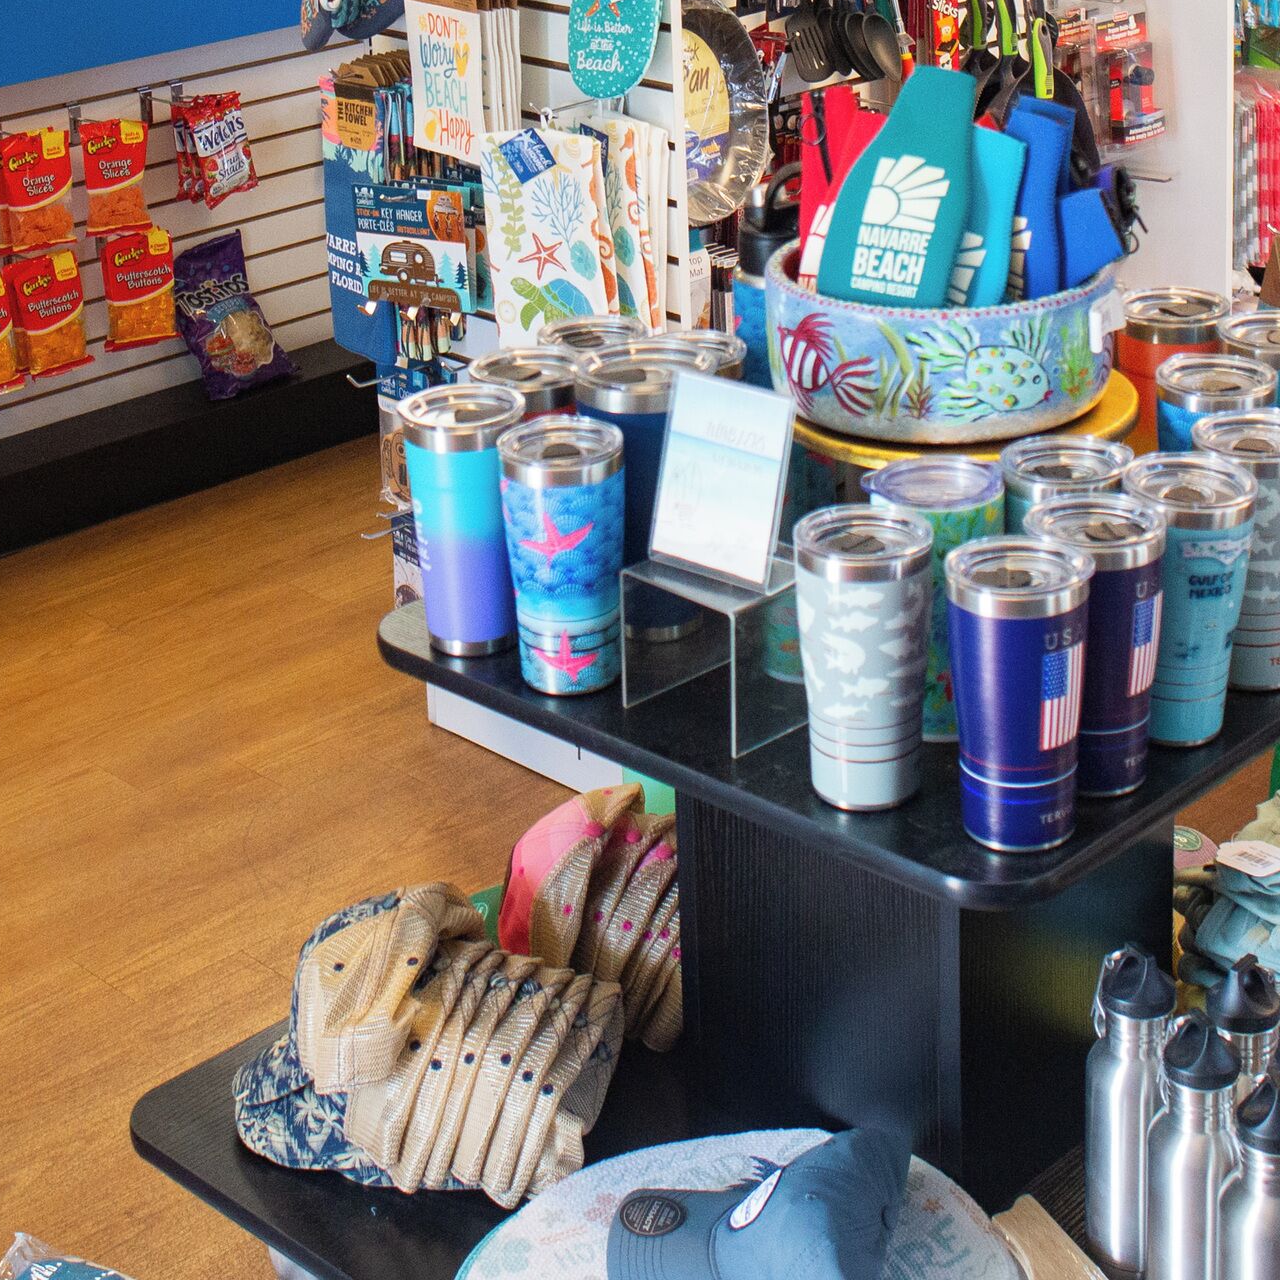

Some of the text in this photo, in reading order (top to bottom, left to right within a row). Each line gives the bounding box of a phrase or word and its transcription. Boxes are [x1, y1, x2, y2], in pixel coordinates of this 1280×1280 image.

[427, 13, 460, 40] DON'T
[576, 20, 633, 34] Life Better
[420, 35, 456, 78] Worry
[577, 49, 624, 72] Beach
[424, 72, 468, 115] BEACH
[345, 103, 372, 117] KITCHEN
[345, 115, 367, 126] TOWEL
[198, 115, 245, 149] Welch's
[439, 110, 474, 155] Happy
[99, 158, 132, 169] Orange
[23, 175, 55, 186] Orange
[102, 168, 130, 179] Slices
[27, 184, 54, 196] Slices
[381, 207, 423, 222] KEY HANGER
[857, 224, 932, 255] NAVARRE
[116, 265, 170, 281] Butterscotch
[852, 247, 926, 284] BEACH
[128, 277, 162, 288] Buttons
[850, 277, 918, 298] CAMPING RESORT
[176, 273, 248, 314] Tostitos
[1189, 575, 1218, 586] GULF
[1189, 586, 1232, 599] MEXICO
